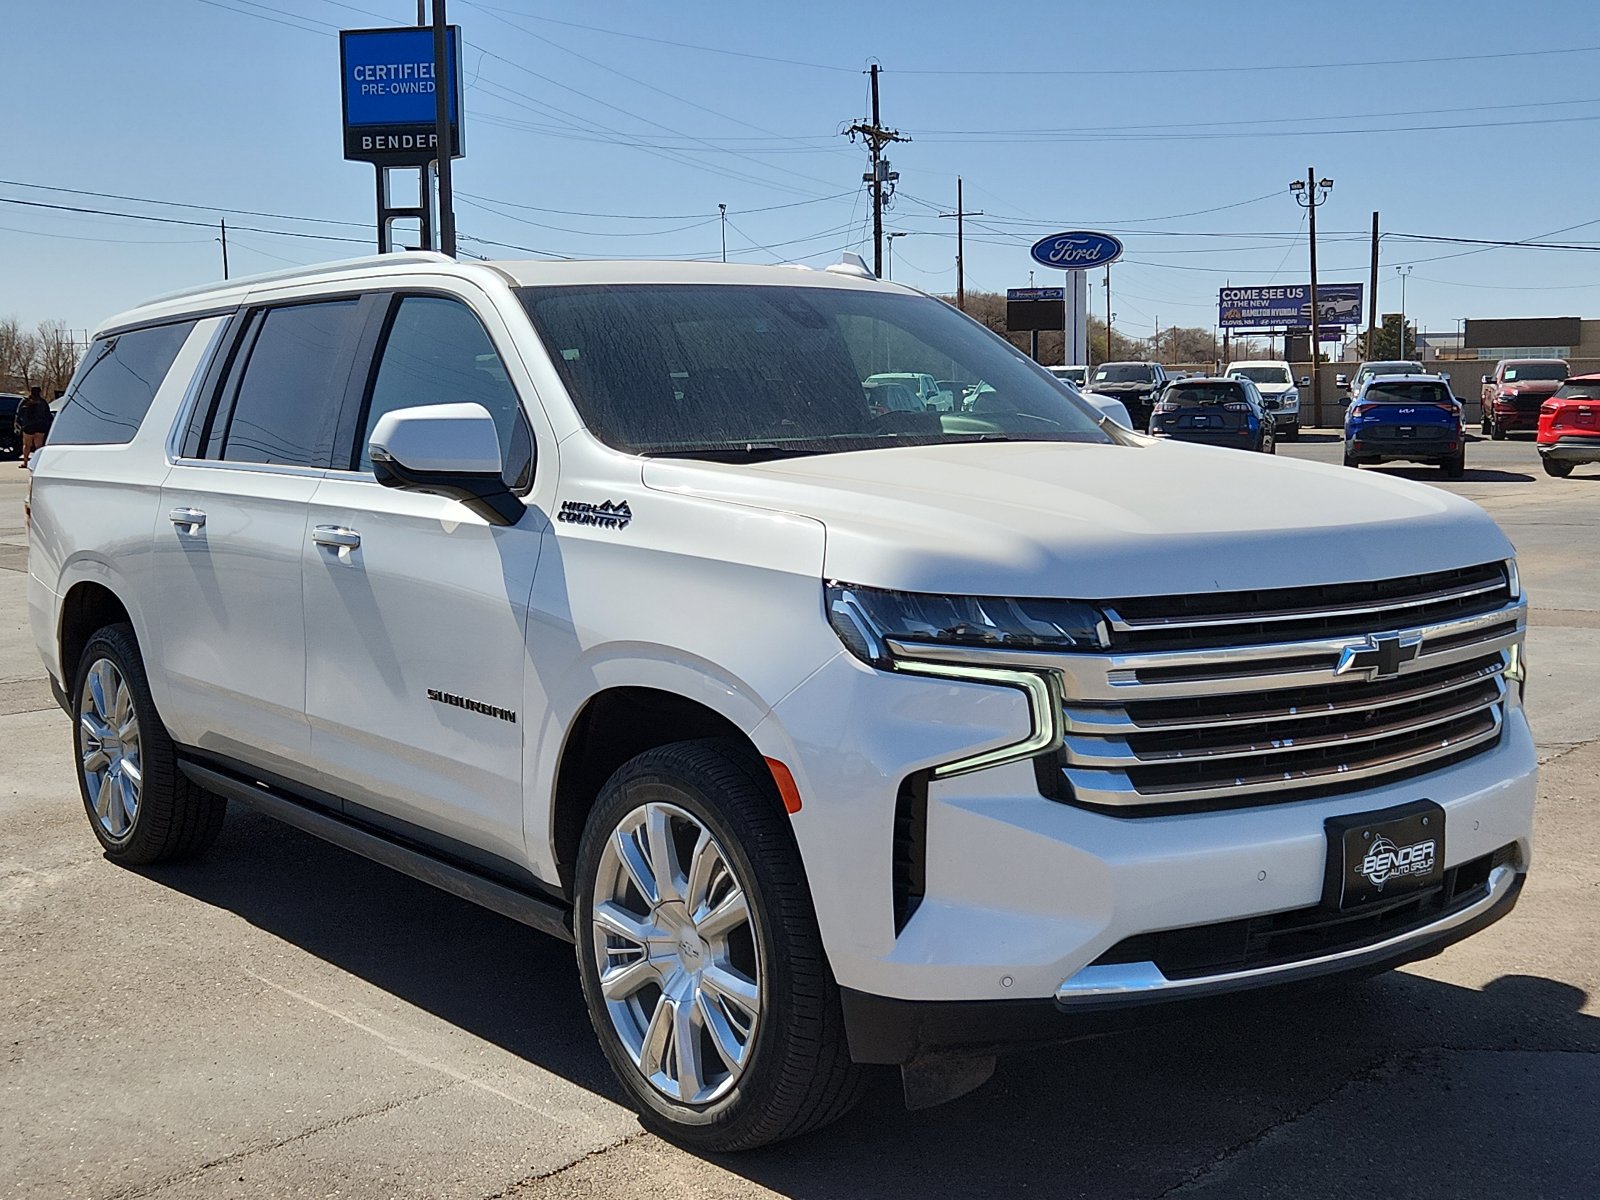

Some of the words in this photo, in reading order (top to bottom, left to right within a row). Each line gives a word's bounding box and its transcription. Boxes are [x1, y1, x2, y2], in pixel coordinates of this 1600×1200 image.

[361, 81, 436, 96] PRE-OWNED
[362, 134, 438, 150] BENDER
[1049, 238, 1102, 261] Ford
[1222, 289, 1261, 301] COME
[1261, 288, 1284, 299] SEE
[1286, 287, 1304, 299] US
[1250, 299, 1270, 307] NEW
[1241, 308, 1271, 318] HAMILTON
[1270, 307, 1298, 317] HYUNDAI
[561, 501, 598, 512] HIGH
[557, 511, 630, 531] COUNTRY
[427, 688, 516, 723] SUBURBAN
[1363, 841, 1435, 874] BENDER
[1390, 864, 1410, 876] AUTO
[1411, 858, 1434, 872] GROUP
